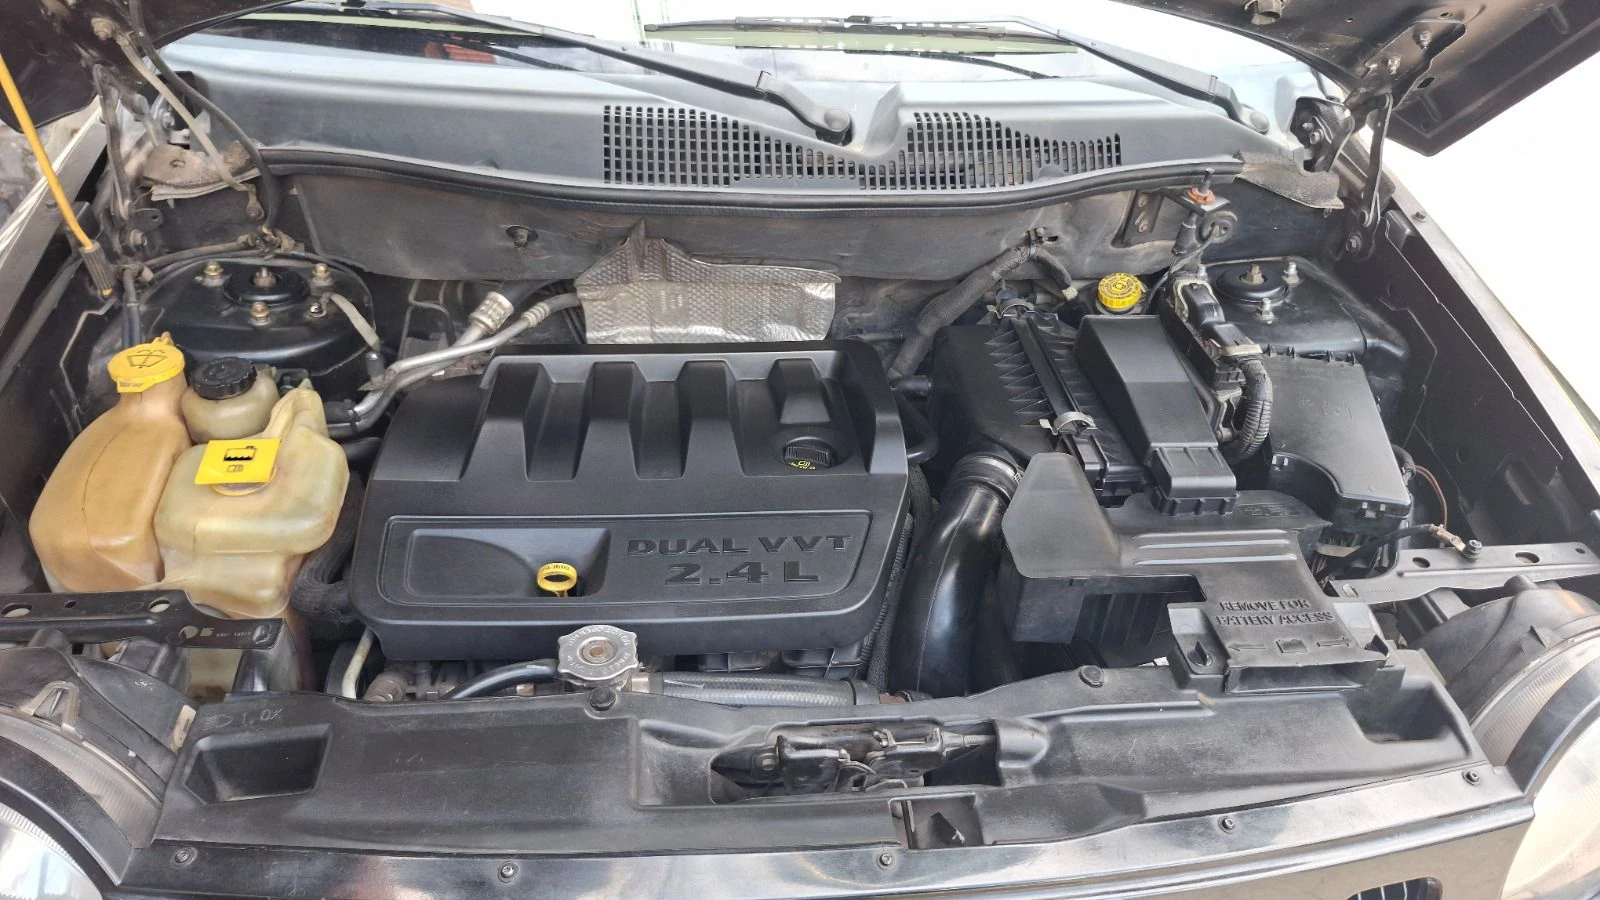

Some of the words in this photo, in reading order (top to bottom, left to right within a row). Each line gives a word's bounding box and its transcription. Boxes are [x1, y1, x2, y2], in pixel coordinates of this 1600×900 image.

[628, 538, 749, 555] DUAL
[758, 535, 850, 552] VVT
[1220, 600, 1279, 611] REMOVE
[1279, 599, 1310, 610] FOR
[1216, 614, 1275, 625] BATTERY
[1279, 611, 1334, 624] ACCESS
